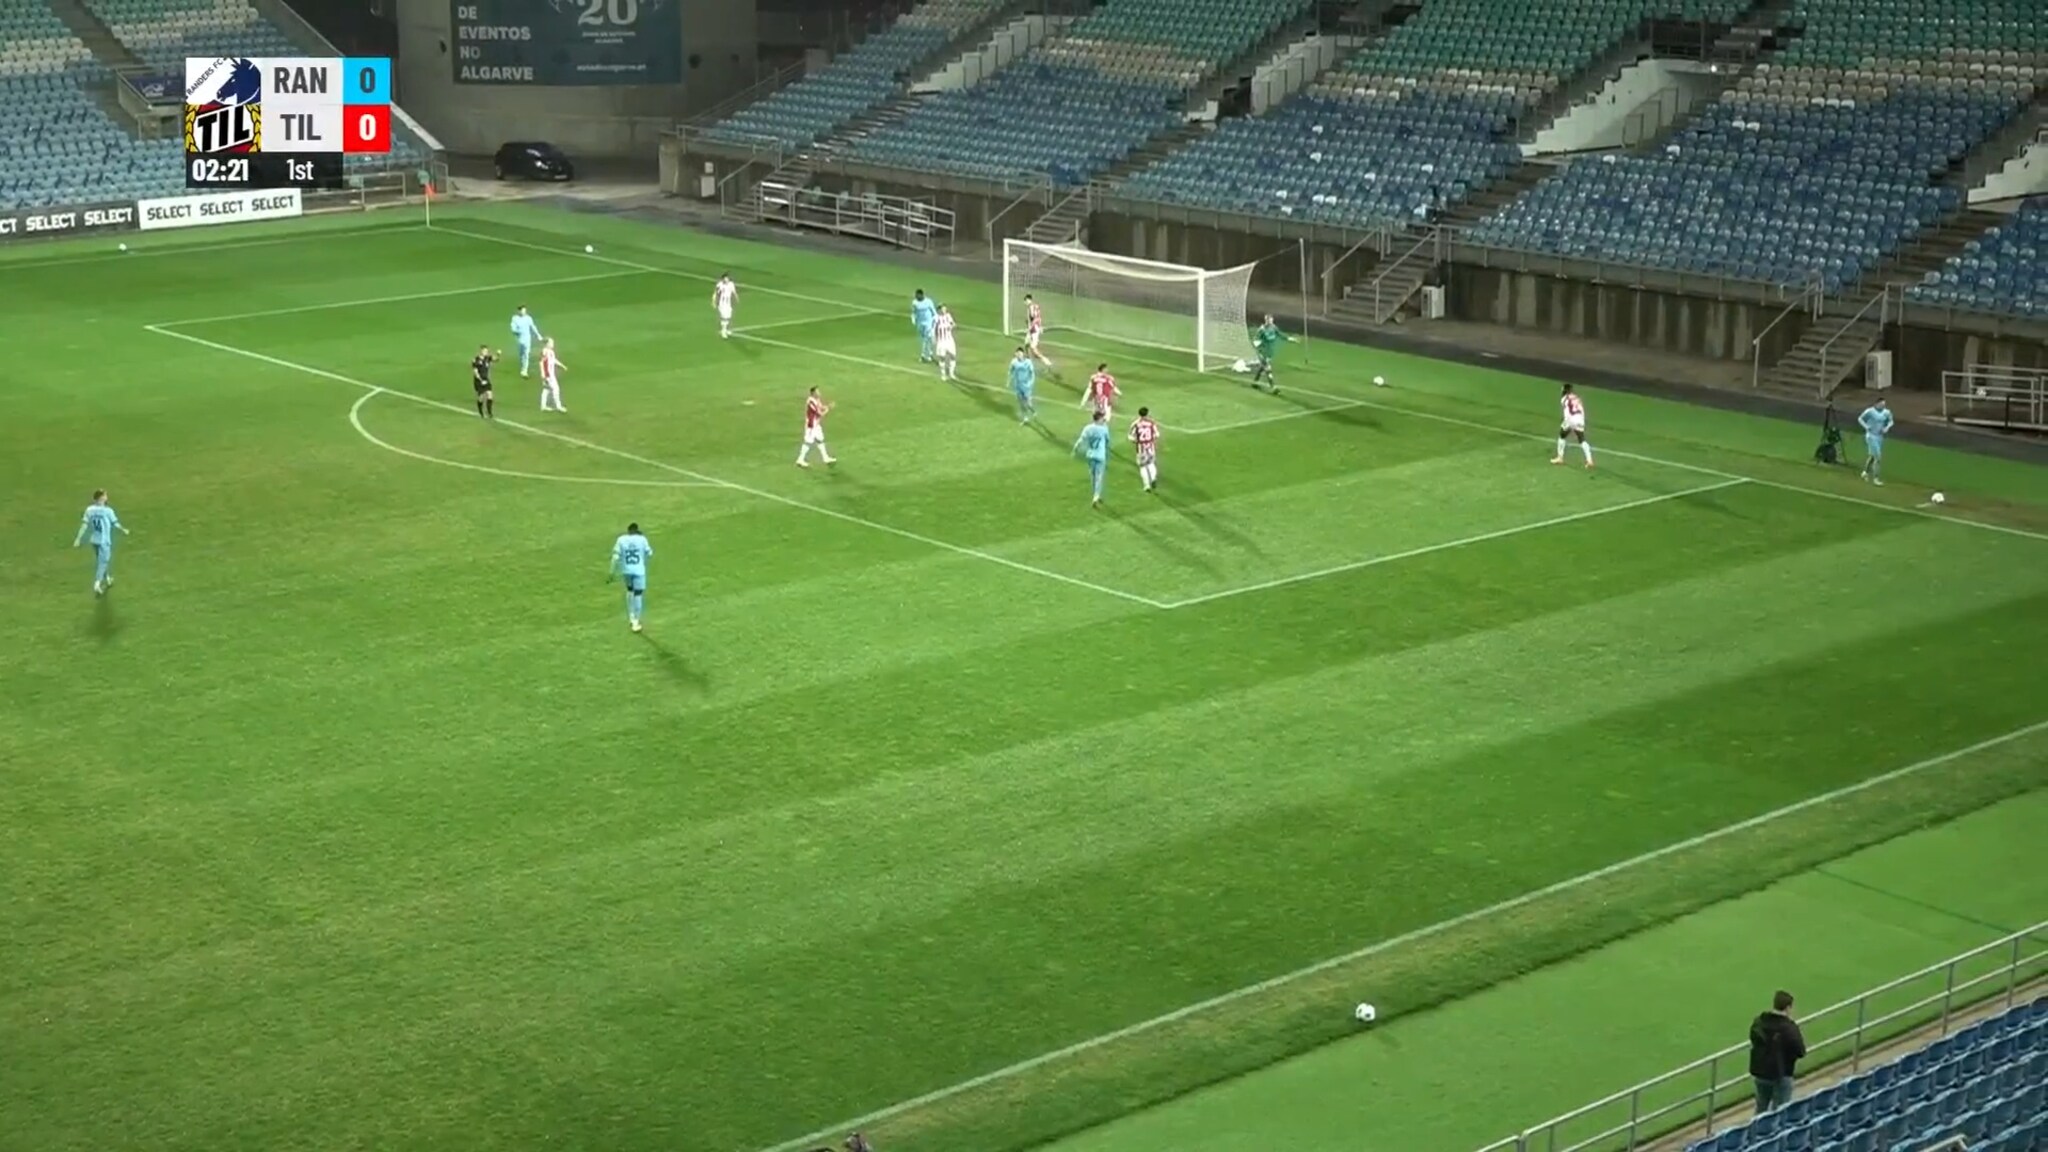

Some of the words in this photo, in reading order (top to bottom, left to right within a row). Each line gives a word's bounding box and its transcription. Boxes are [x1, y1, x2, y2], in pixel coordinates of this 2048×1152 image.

[457, 5, 478, 20] DE
[458, 25, 531, 41] EVENTOS
[459, 45, 481, 59] NO
[461, 65, 534, 81] ALGARVE
[147, 204, 192, 221] SELECT
[199, 200, 244, 217] SELECT
[251, 195, 295, 212] SELECT
[26, 212, 77, 231] SELECT
[84, 207, 133, 227] SELECT
[625, 549, 640, 565] 25
